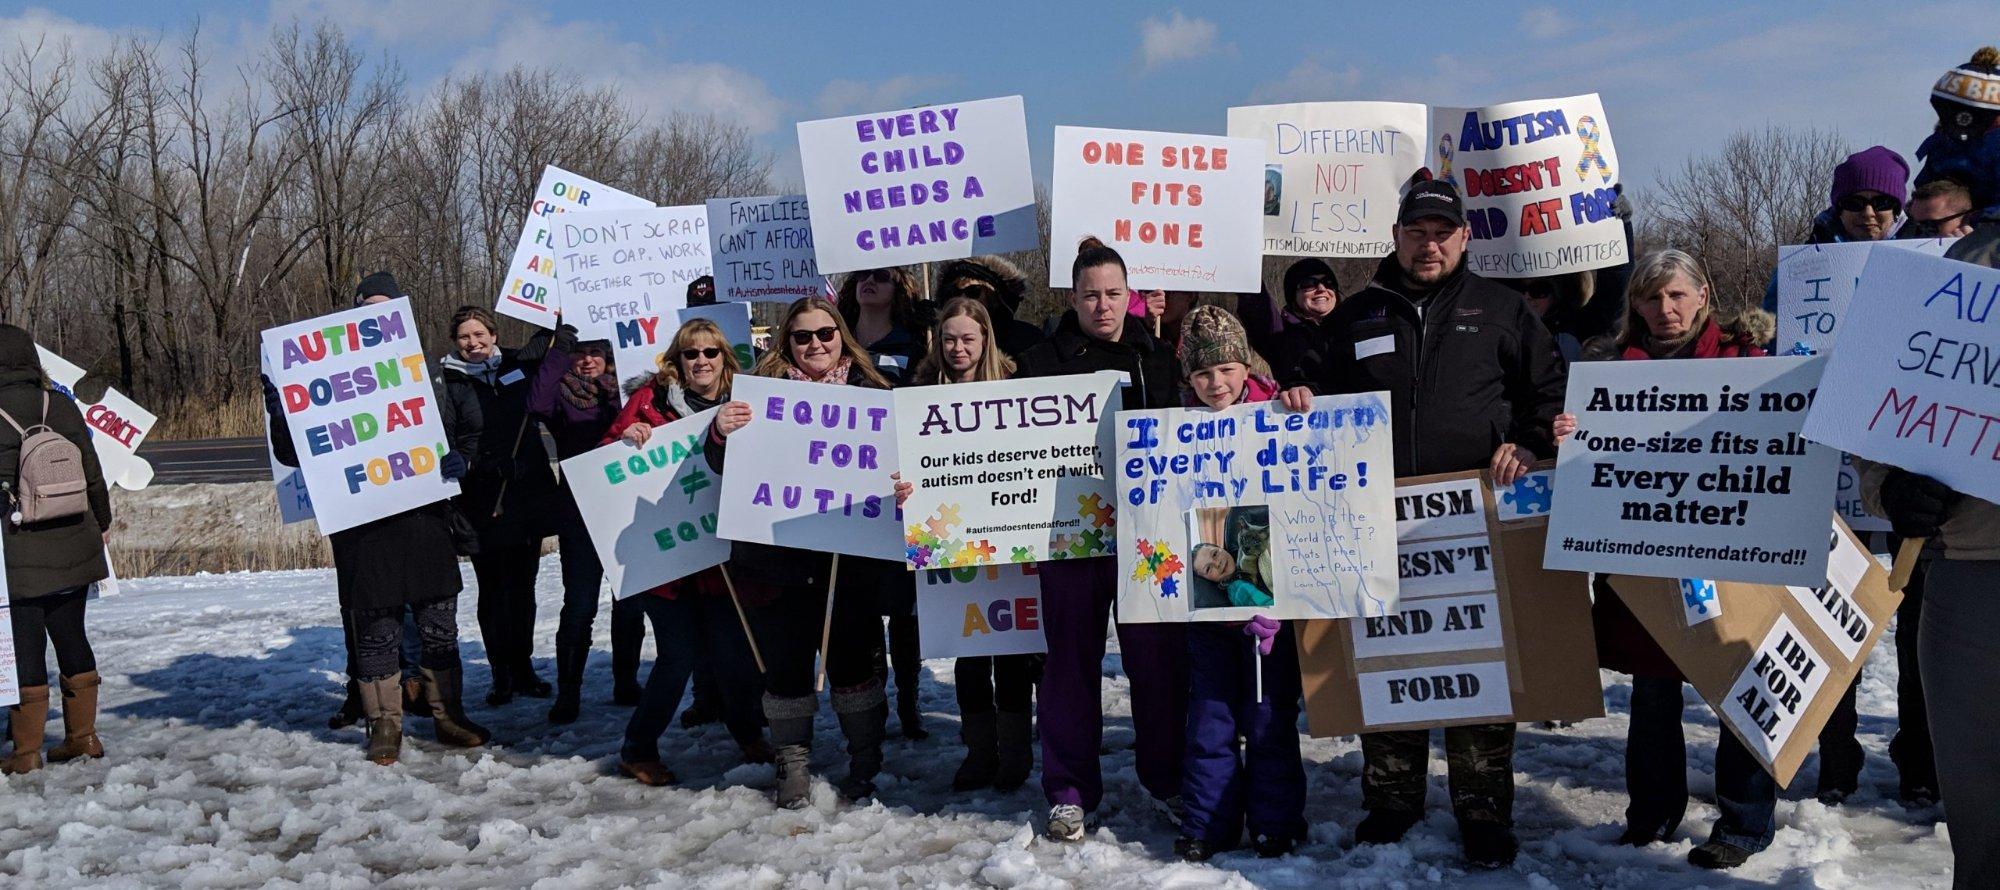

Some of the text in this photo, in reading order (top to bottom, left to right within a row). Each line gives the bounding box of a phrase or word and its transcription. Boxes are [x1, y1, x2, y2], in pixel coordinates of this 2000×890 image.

[856, 108, 959, 143] EVERY
[1277, 123, 1401, 156] DIFFERENT
[1459, 109, 1571, 152] AUTISM
[861, 141, 965, 174] CHILD
[1082, 141, 1228, 171] ONE SIZE
[1315, 163, 1364, 195] NOT
[1464, 156, 1561, 198] DOESN'T
[553, 182, 591, 206] OUR
[843, 176, 984, 214] NEEDS A
[1131, 181, 1203, 206] FITS
[730, 200, 809, 226] FAMILIES
[1291, 198, 1367, 234] LESS!
[1466, 207, 1508, 241] ND
[1520, 198, 1563, 237] AT
[565, 217, 705, 248] DON'T SCRAP
[719, 229, 758, 255] CAN'T
[856, 215, 996, 251] CHANCE
[1115, 219, 1203, 248] NONE
[527, 255, 558, 279] AR
[563, 242, 705, 272] THE OAP. WORK
[726, 259, 819, 283] THIS PLAN
[511, 278, 547, 304] FOR
[566, 266, 711, 294] TOGETHER TO MAKE
[1804, 277, 1831, 302] I
[588, 292, 651, 324] BETTER!
[1795, 312, 1836, 335] TO
[283, 311, 406, 370] AUTISM
[615, 316, 660, 349] MY
[1897, 330, 2000, 388] SERV
[1586, 386, 1709, 412] Autism
[1718, 385, 1750, 412] is
[305, 397, 425, 456] END AT
[766, 397, 888, 432] EQUIT
[919, 393, 1098, 436] AUTISM
[1868, 387, 2000, 461] MATT
[1127, 417, 1159, 449] I
[1177, 417, 1235, 443] can
[1710, 431, 1759, 455] fits
[808, 440, 878, 470] FOR
[920, 444, 1102, 469] Our kids deserve better,
[1125, 438, 1323, 479] every day
[921, 462, 1104, 489] autism doesn’t end with
[1194, 477, 1248, 504] my
[1591, 463, 1792, 497] Every child
[991, 488, 1038, 506] Ford!
[1395, 489, 1476, 521] TISM
[966, 518, 1080, 535] #autismdoesntendatford!!
[1285, 509, 1315, 524] Who
[1341, 507, 1366, 522] the
[1621, 500, 1748, 526] matter!
[1286, 532, 1318, 543] World
[1333, 547, 1356, 556] the
[1563, 537, 1807, 566] #autismdoesntendatford!!
[1291, 560, 1374, 575] Great Puzzle!
[962, 597, 1040, 637] AGE
[1366, 603, 1486, 638] END AT
[1775, 631, 1816, 684] IBI
[1387, 672, 1481, 704] FORD
[1753, 652, 1802, 715] FOR
[1736, 685, 1781, 742] ALL
